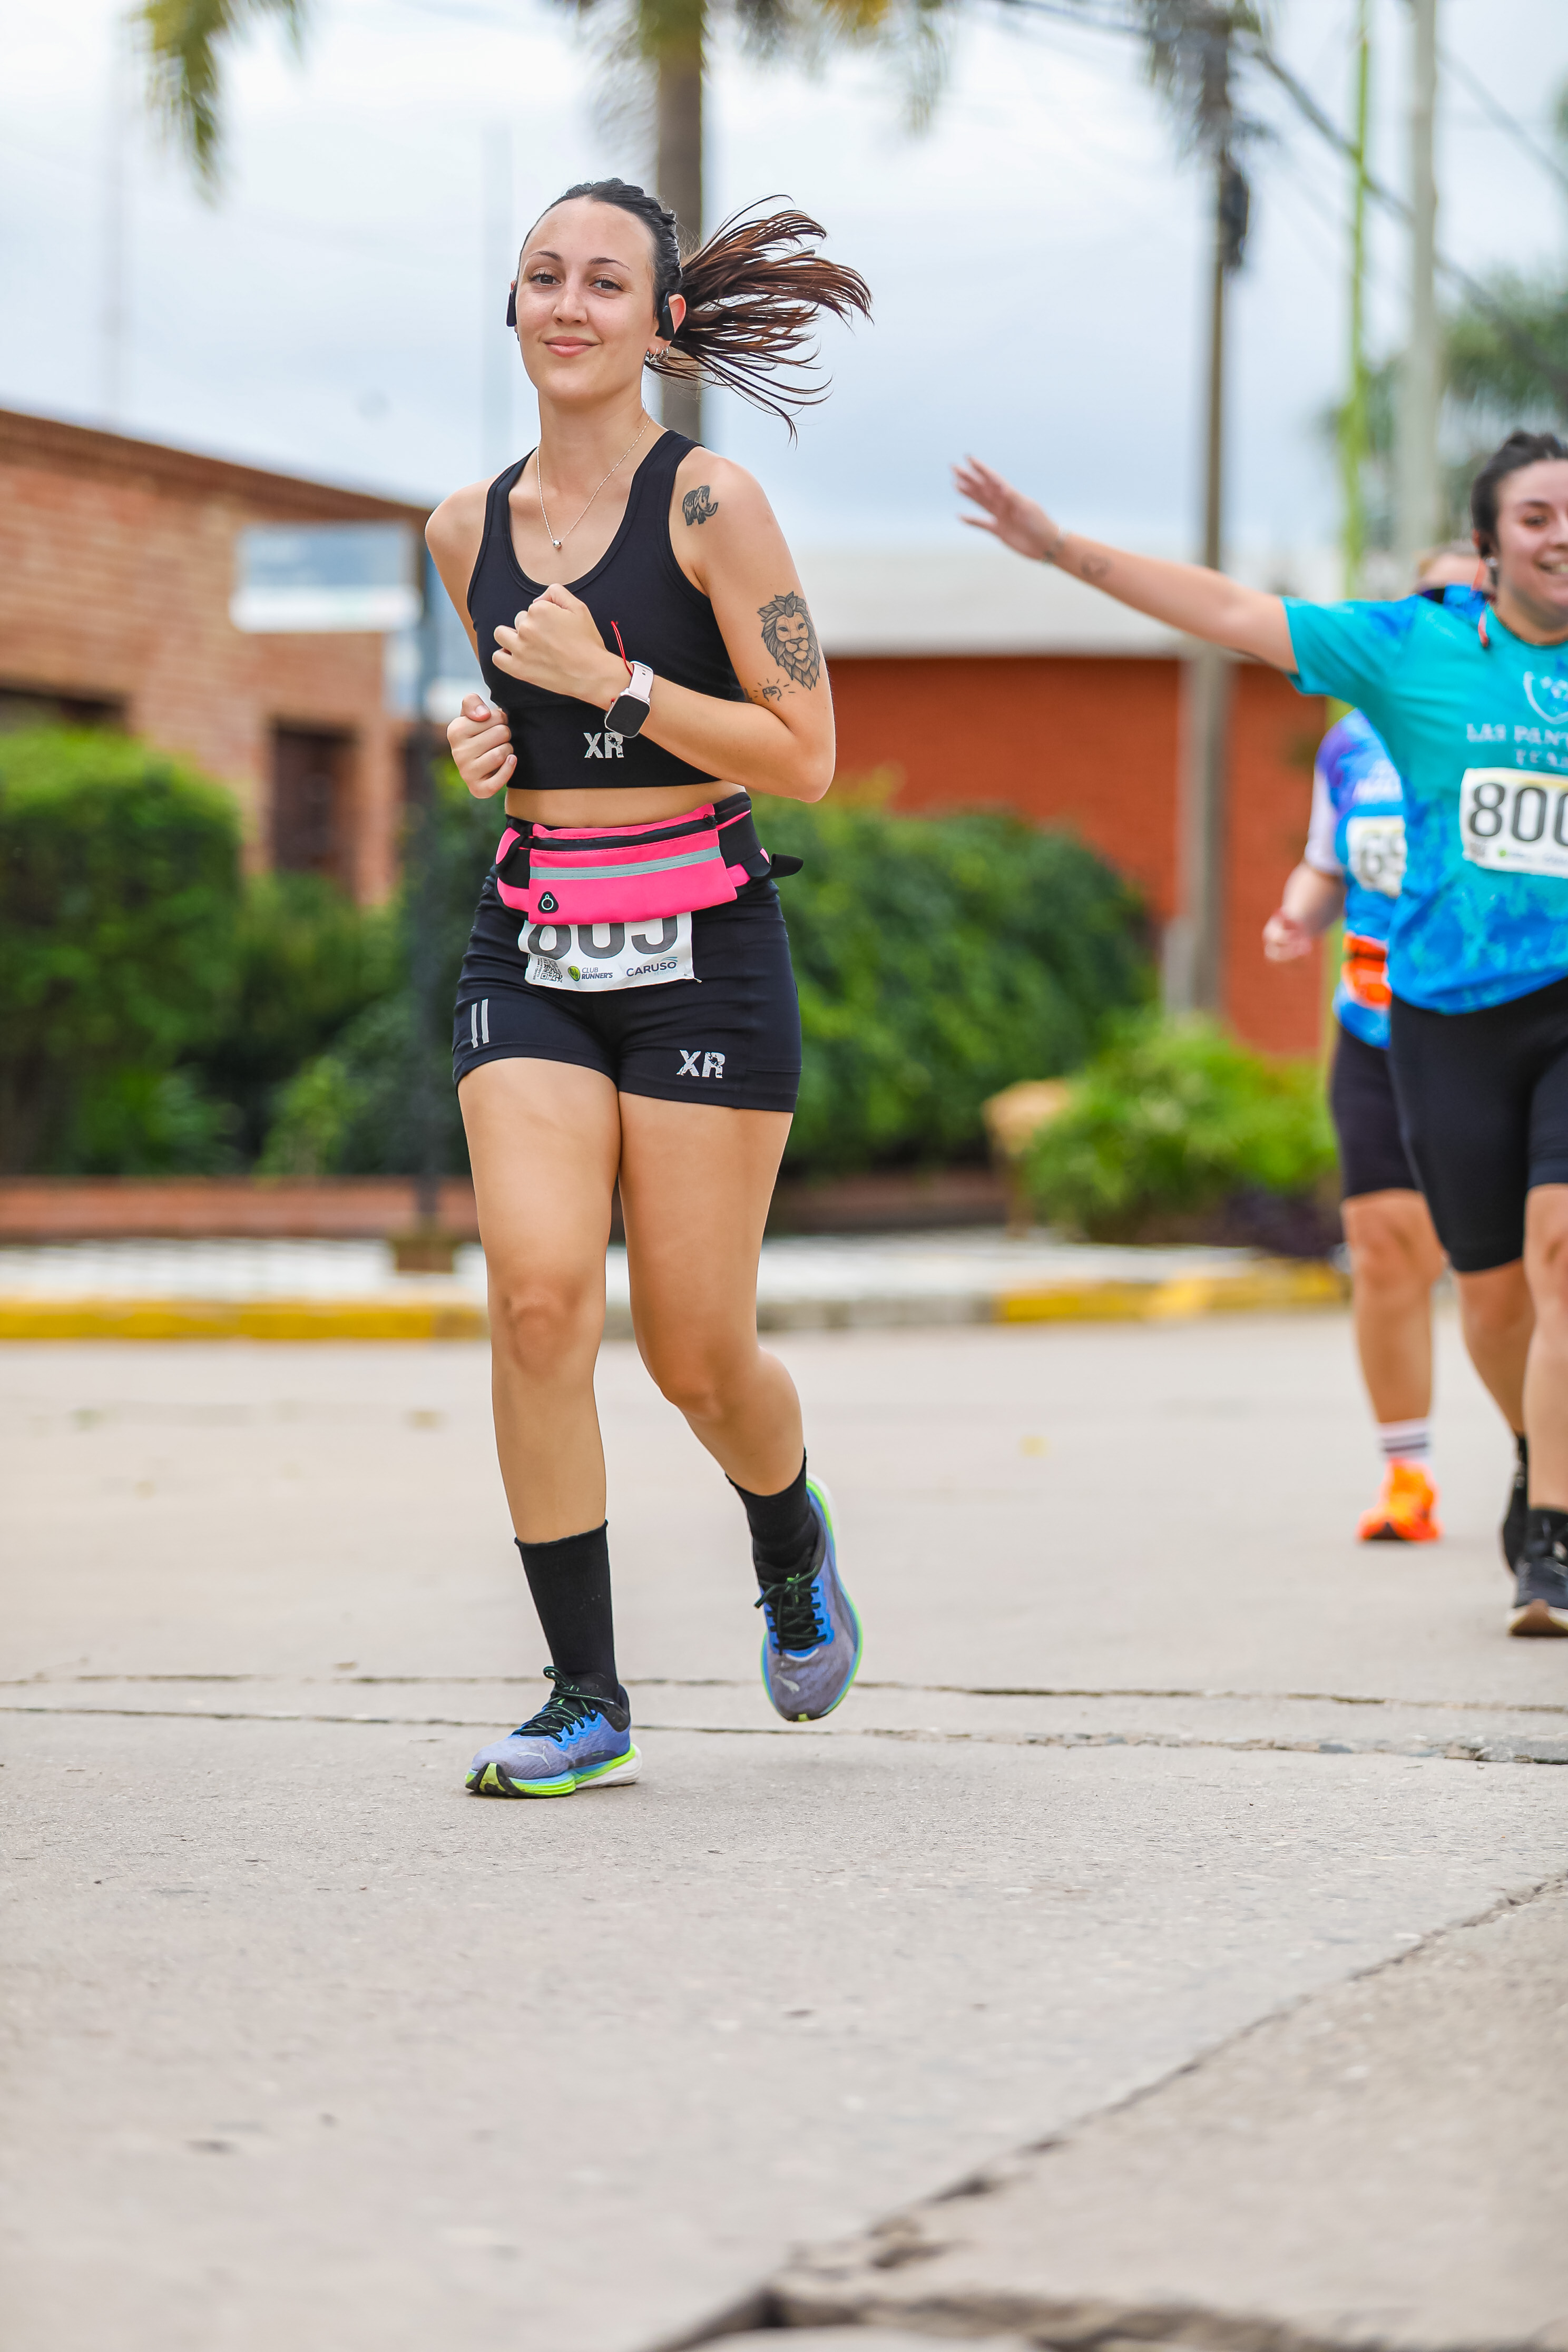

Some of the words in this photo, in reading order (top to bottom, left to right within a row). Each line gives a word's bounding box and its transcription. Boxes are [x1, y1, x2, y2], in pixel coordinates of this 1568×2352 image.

[583, 732, 624, 758] XR
[626, 962, 677, 977] CARUSO
[677, 1050, 725, 1079] XR
